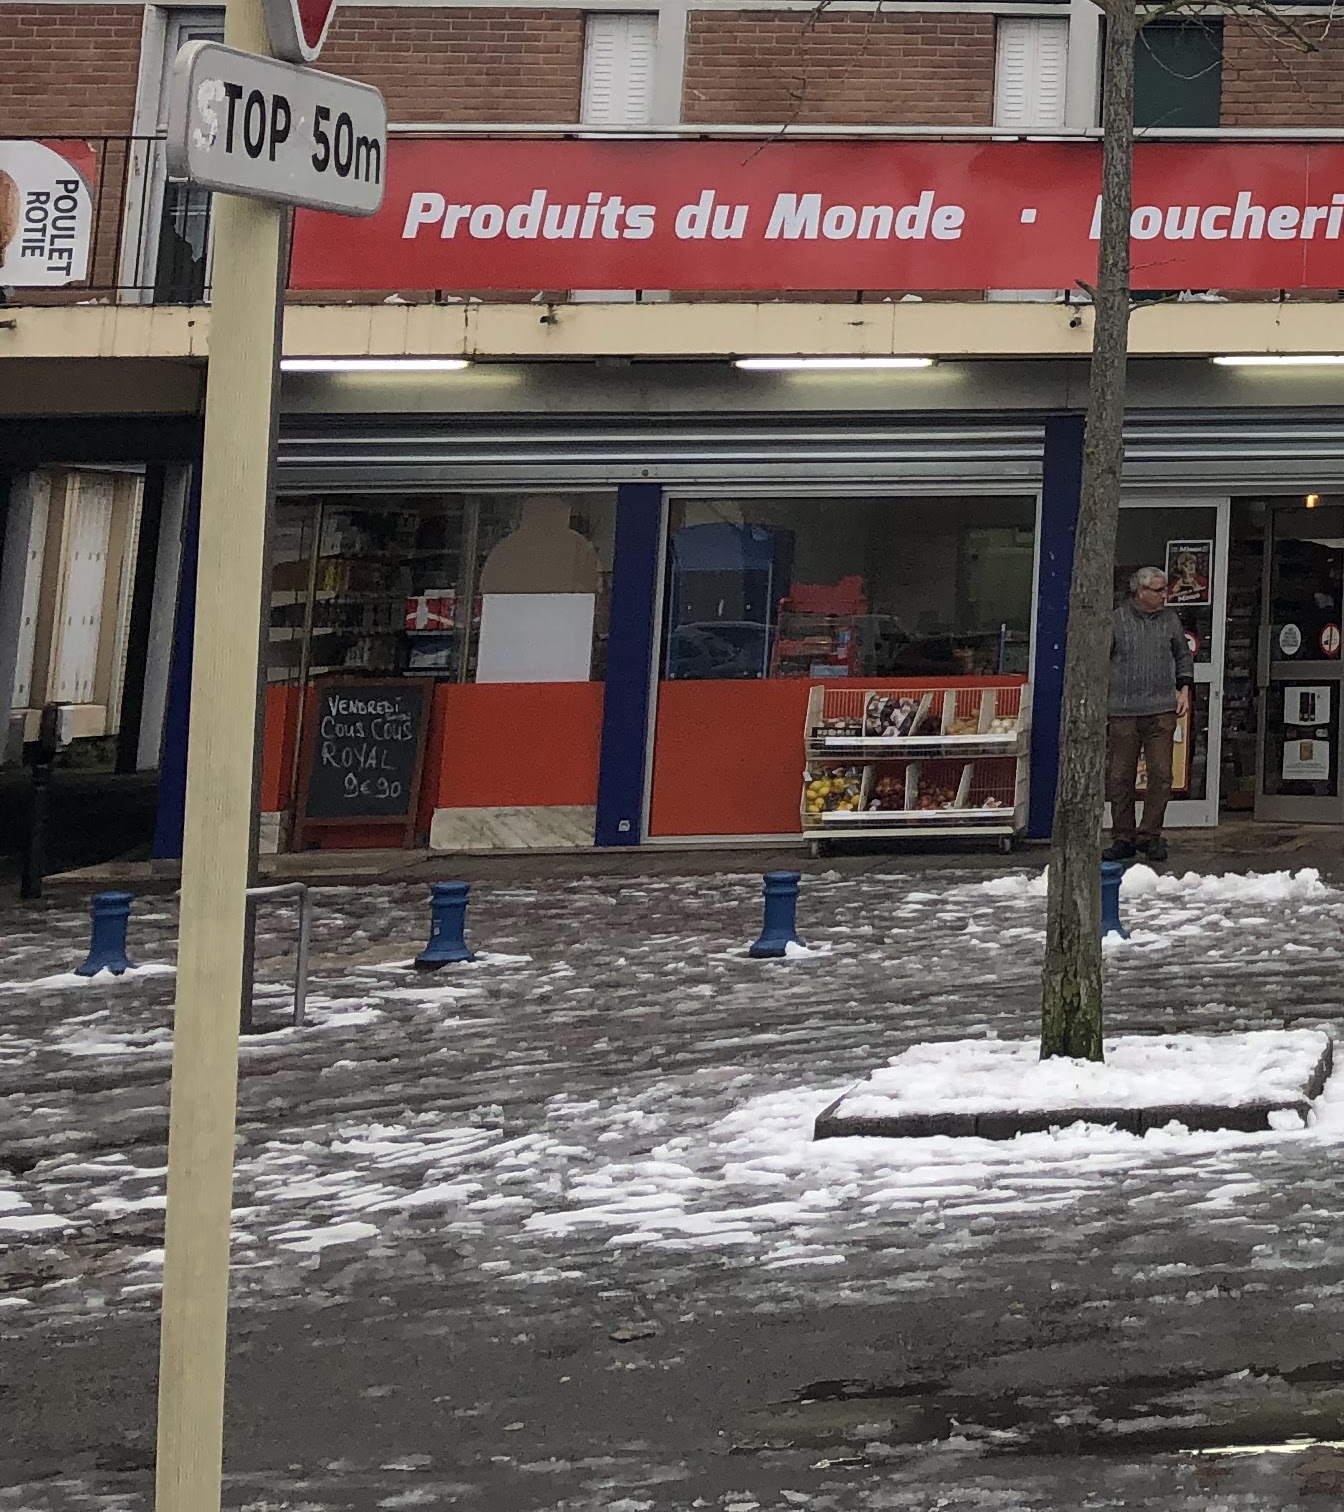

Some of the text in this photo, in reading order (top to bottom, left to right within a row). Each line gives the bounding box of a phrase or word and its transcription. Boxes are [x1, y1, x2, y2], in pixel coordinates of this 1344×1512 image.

[311, 104, 381, 185] 50m
[20, 191, 51, 258] ROTIE
[46, 179, 80, 277] POULET
[400, 189, 657, 240] Produits
[674, 189, 750, 240] du
[763, 190, 966, 240] Monde
[321, 740, 398, 769] ROYAL
